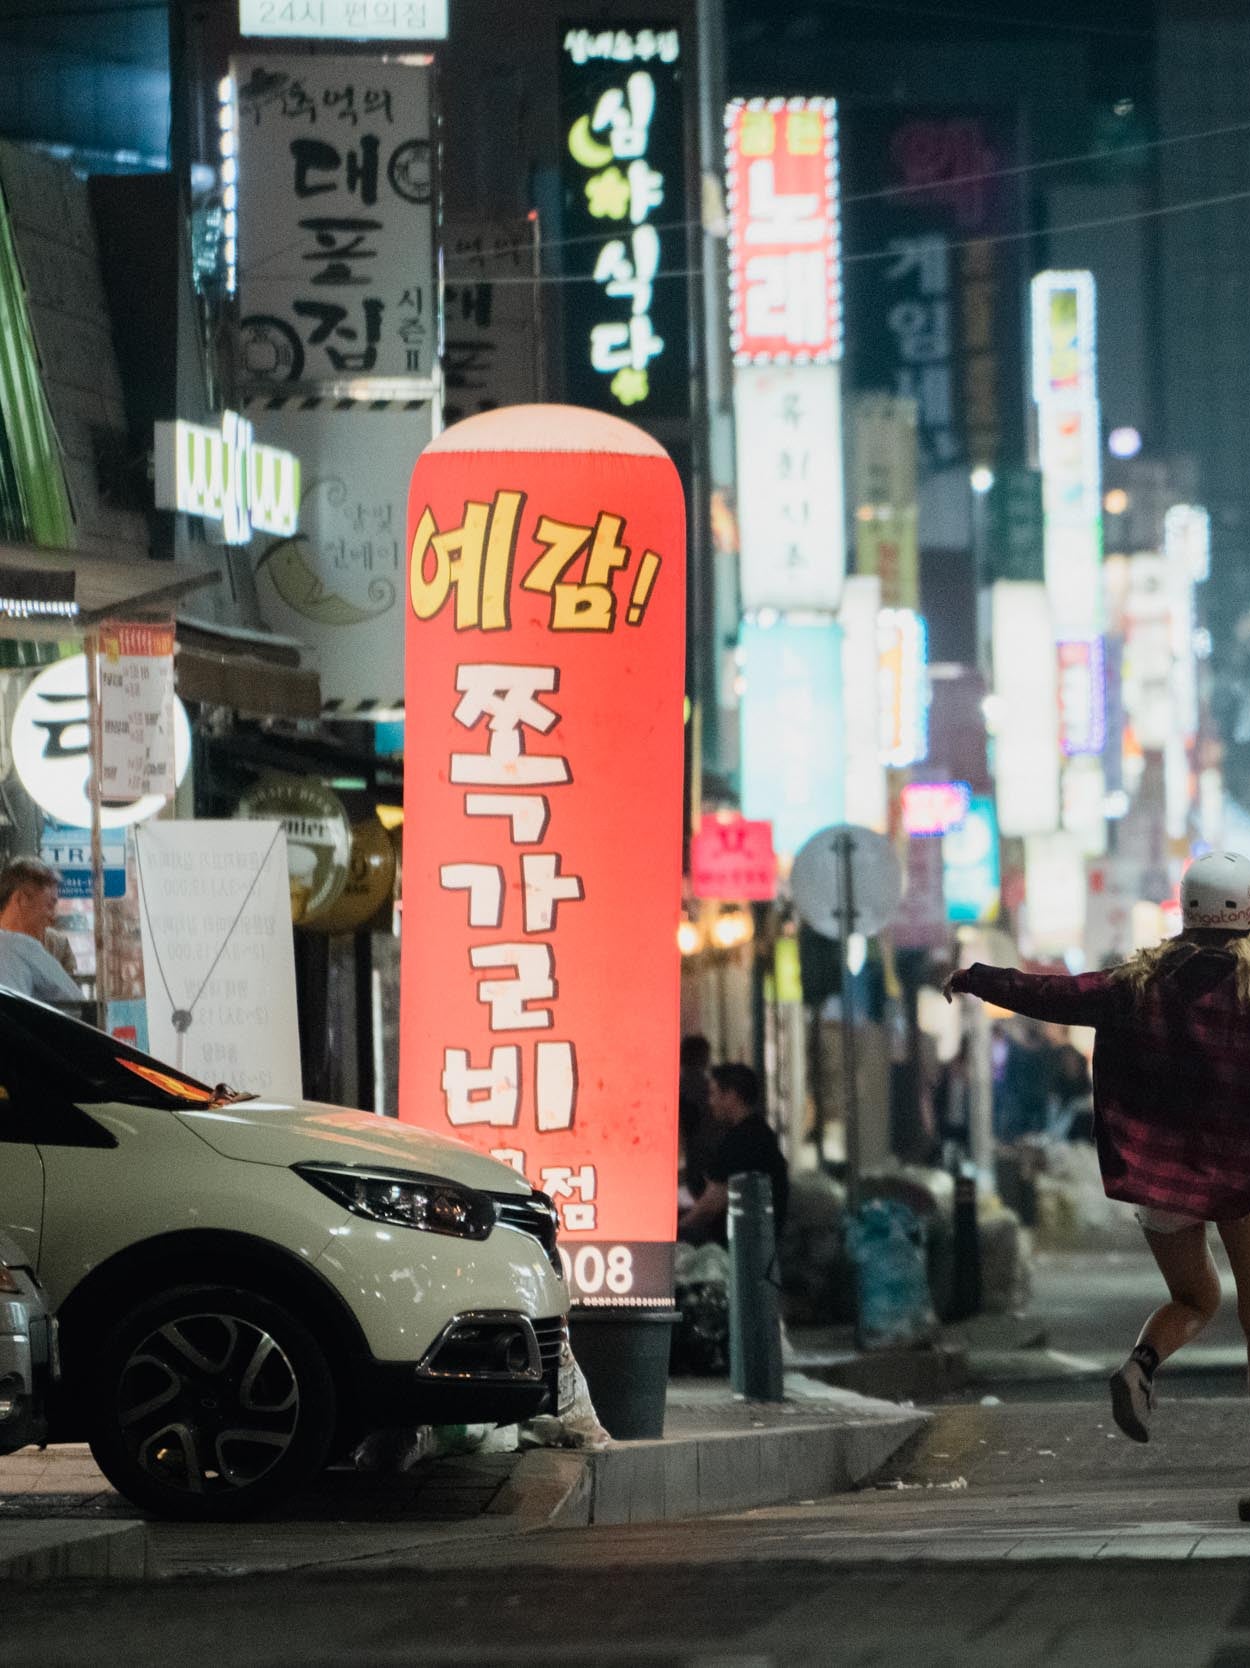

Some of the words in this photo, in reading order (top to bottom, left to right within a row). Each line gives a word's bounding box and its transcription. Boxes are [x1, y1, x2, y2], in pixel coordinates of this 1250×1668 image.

[289, 134, 384, 372] 대포집
[743, 158, 828, 346] 노래
[410, 489, 662, 633] 예감!
[440, 663, 584, 1134] 쪽갈비
